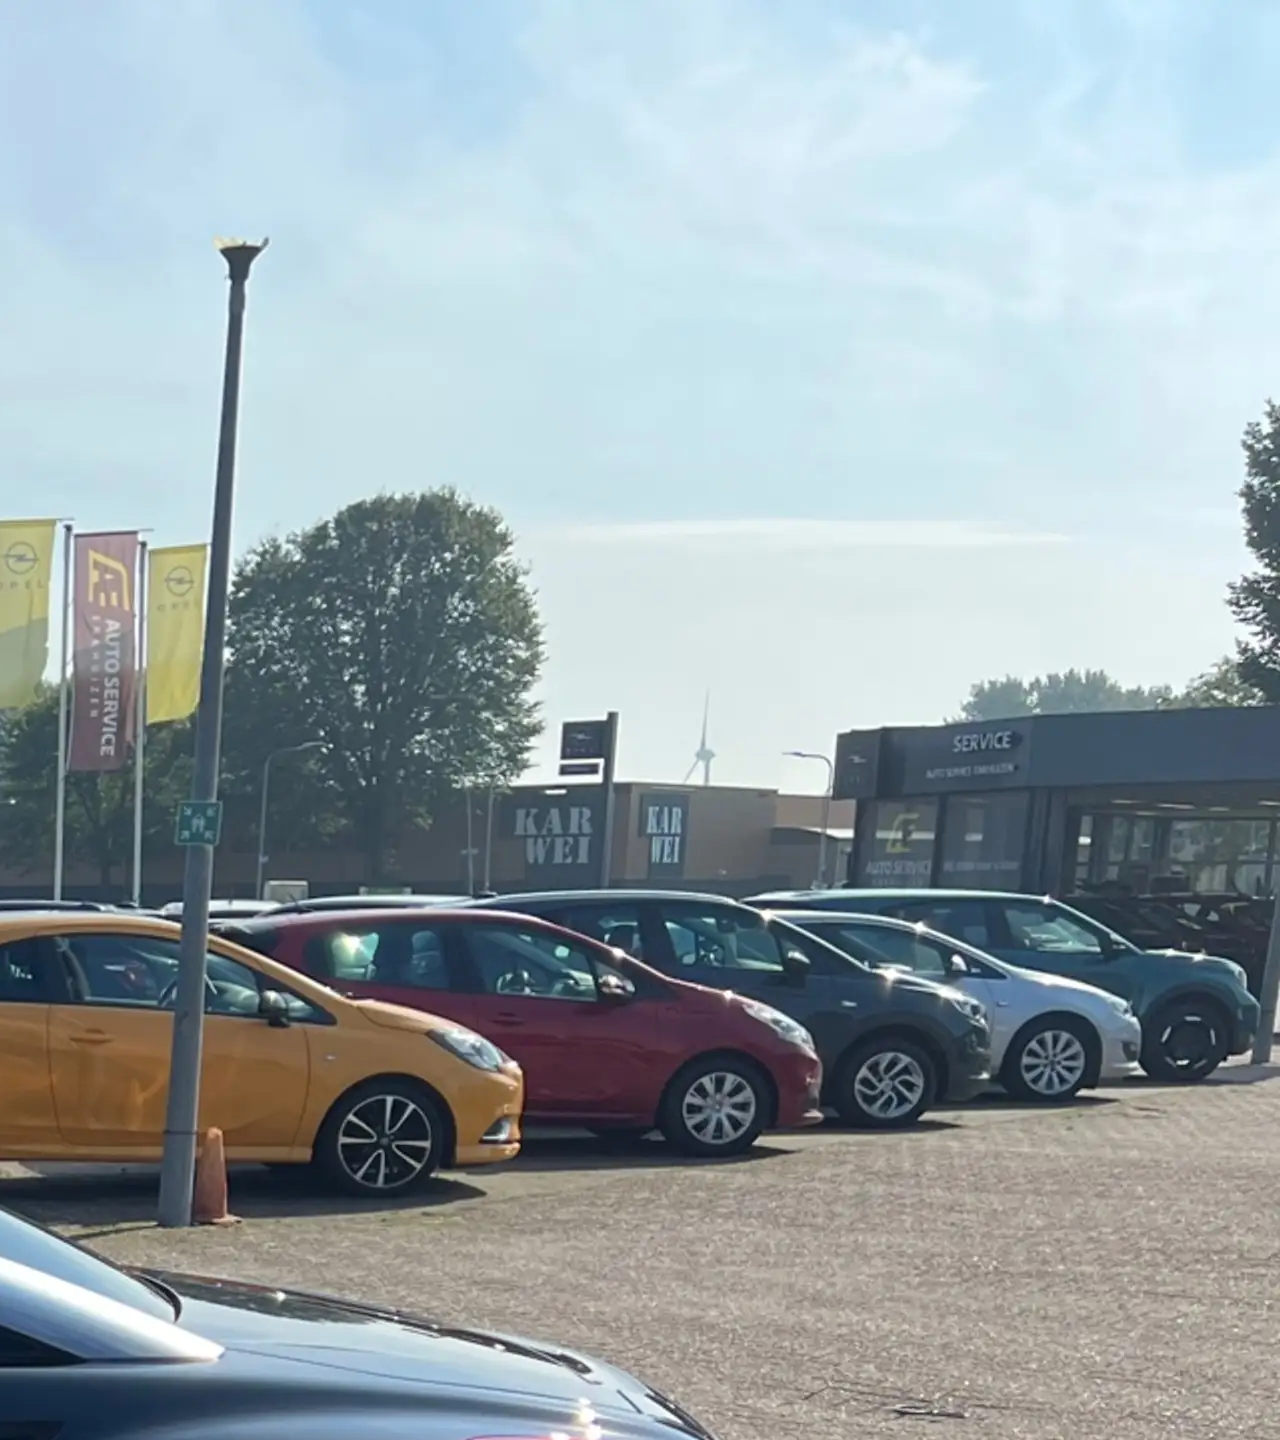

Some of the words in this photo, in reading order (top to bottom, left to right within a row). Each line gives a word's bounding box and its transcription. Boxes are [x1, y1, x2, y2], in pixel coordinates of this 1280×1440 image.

[953, 731, 1013, 753] SERVICE
[514, 806, 593, 835] KAR
[646, 806, 682, 834] KAR
[525, 836, 591, 865] WEI
[651, 836, 681, 864] WEI
